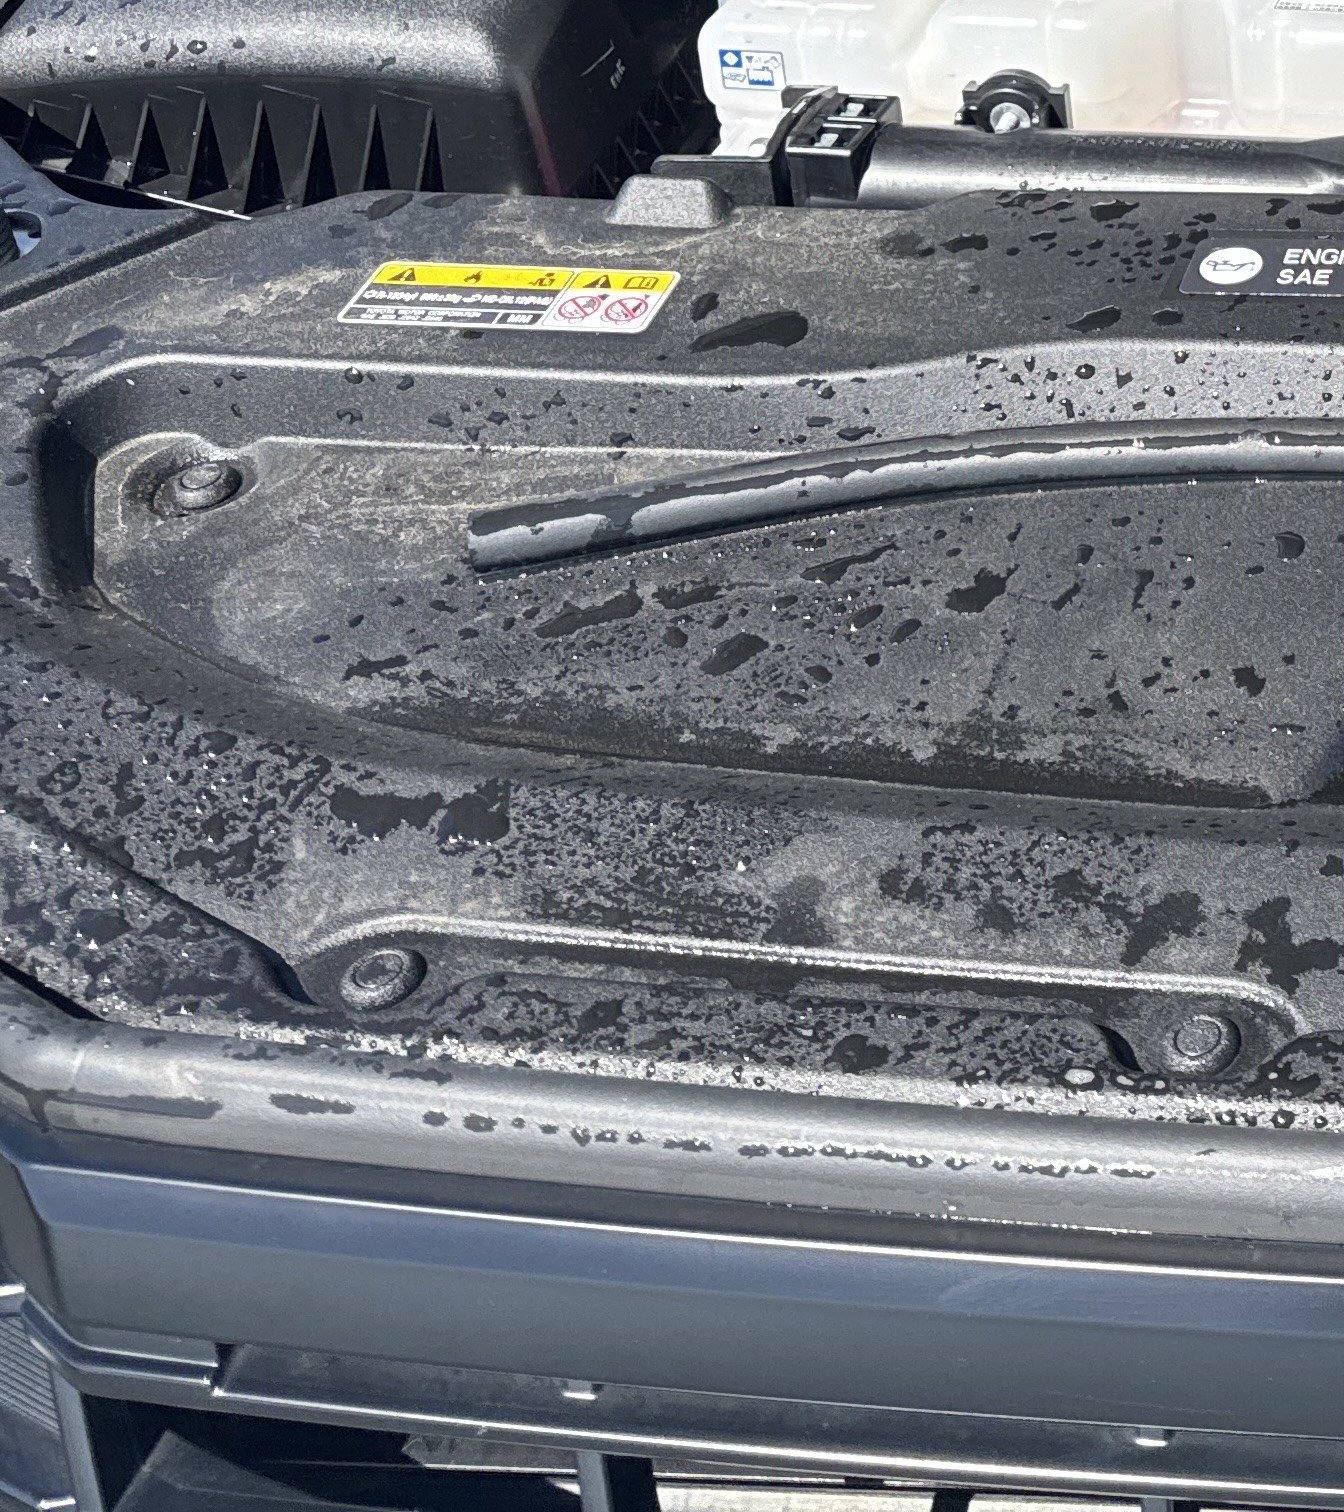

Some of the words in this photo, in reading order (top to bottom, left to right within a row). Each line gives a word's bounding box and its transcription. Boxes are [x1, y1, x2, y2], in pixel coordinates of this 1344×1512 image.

[1276, 268, 1333, 285] SAE
[366, 307, 396, 315] TOYOTA
[428, 310, 482, 318] CORPORATION
